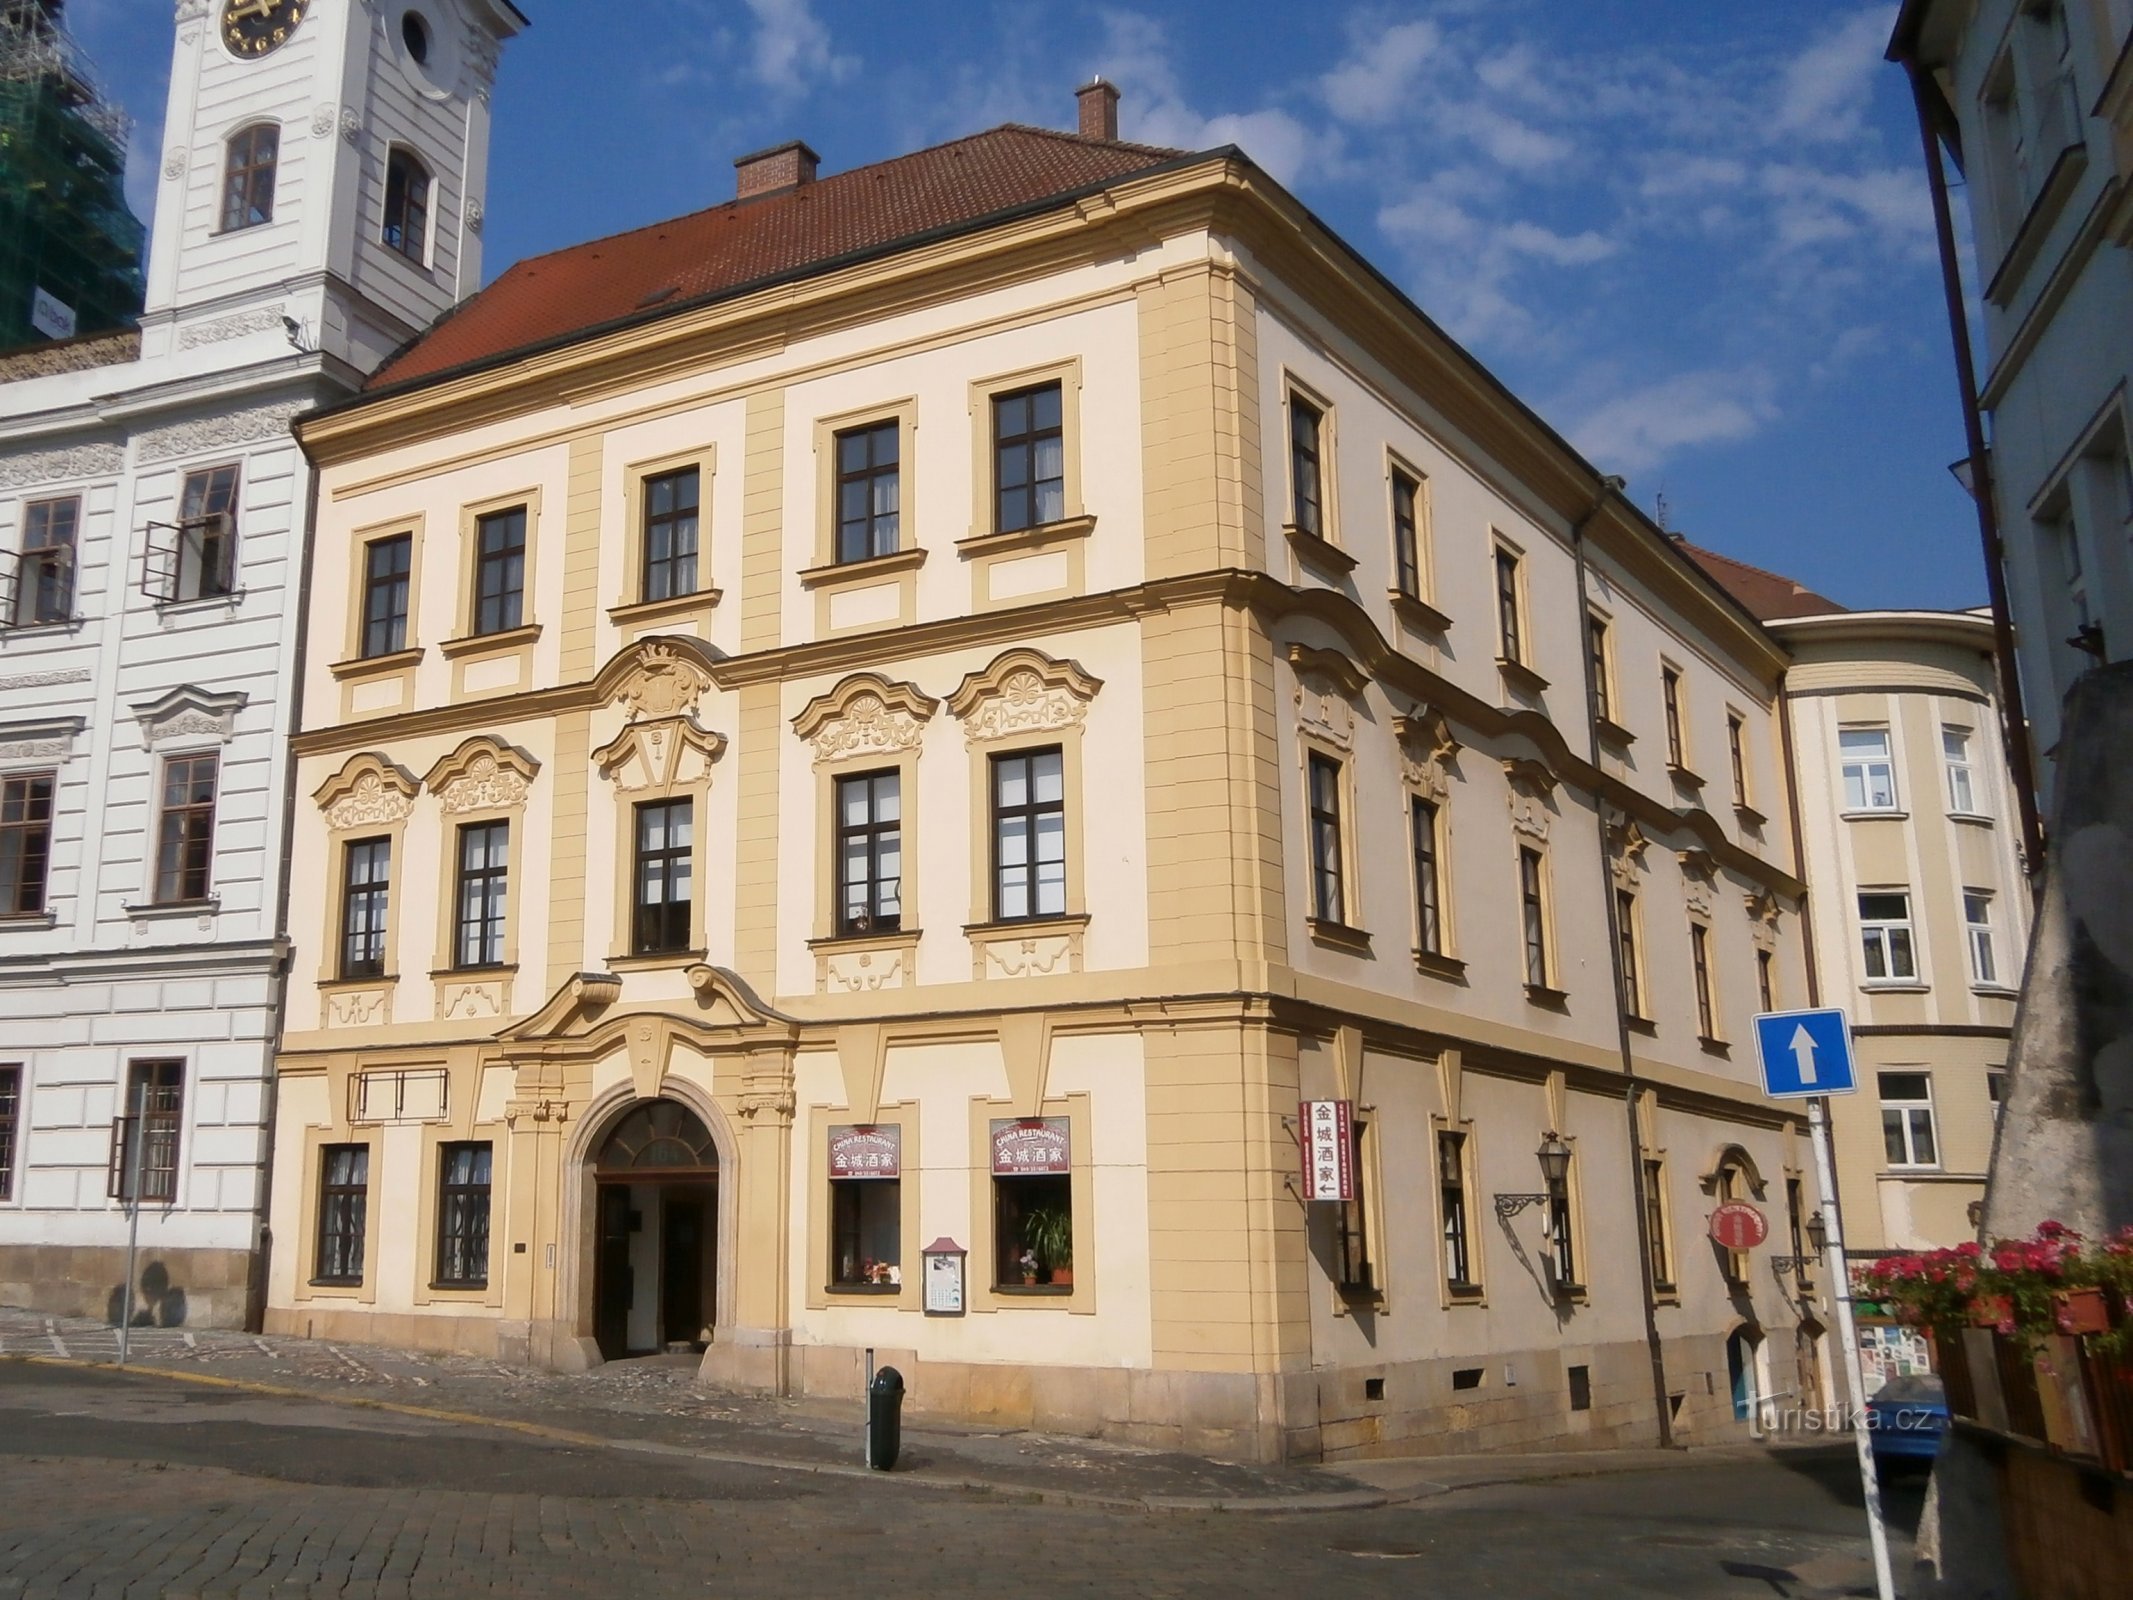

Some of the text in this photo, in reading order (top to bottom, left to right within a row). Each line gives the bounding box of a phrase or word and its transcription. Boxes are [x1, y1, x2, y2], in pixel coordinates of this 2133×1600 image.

[273, 27, 286, 42] 5
[255, 36, 268, 55] 6
[833, 1135, 896, 1151] CHINA RESTAURANT
[996, 1128, 1065, 1146] CHINA RESTAURANT
[1315, 1104, 1334, 1182] 金城酒家
[835, 1153, 893, 1168] 金城酒家
[998, 1147, 1063, 1164] 金城酒家
